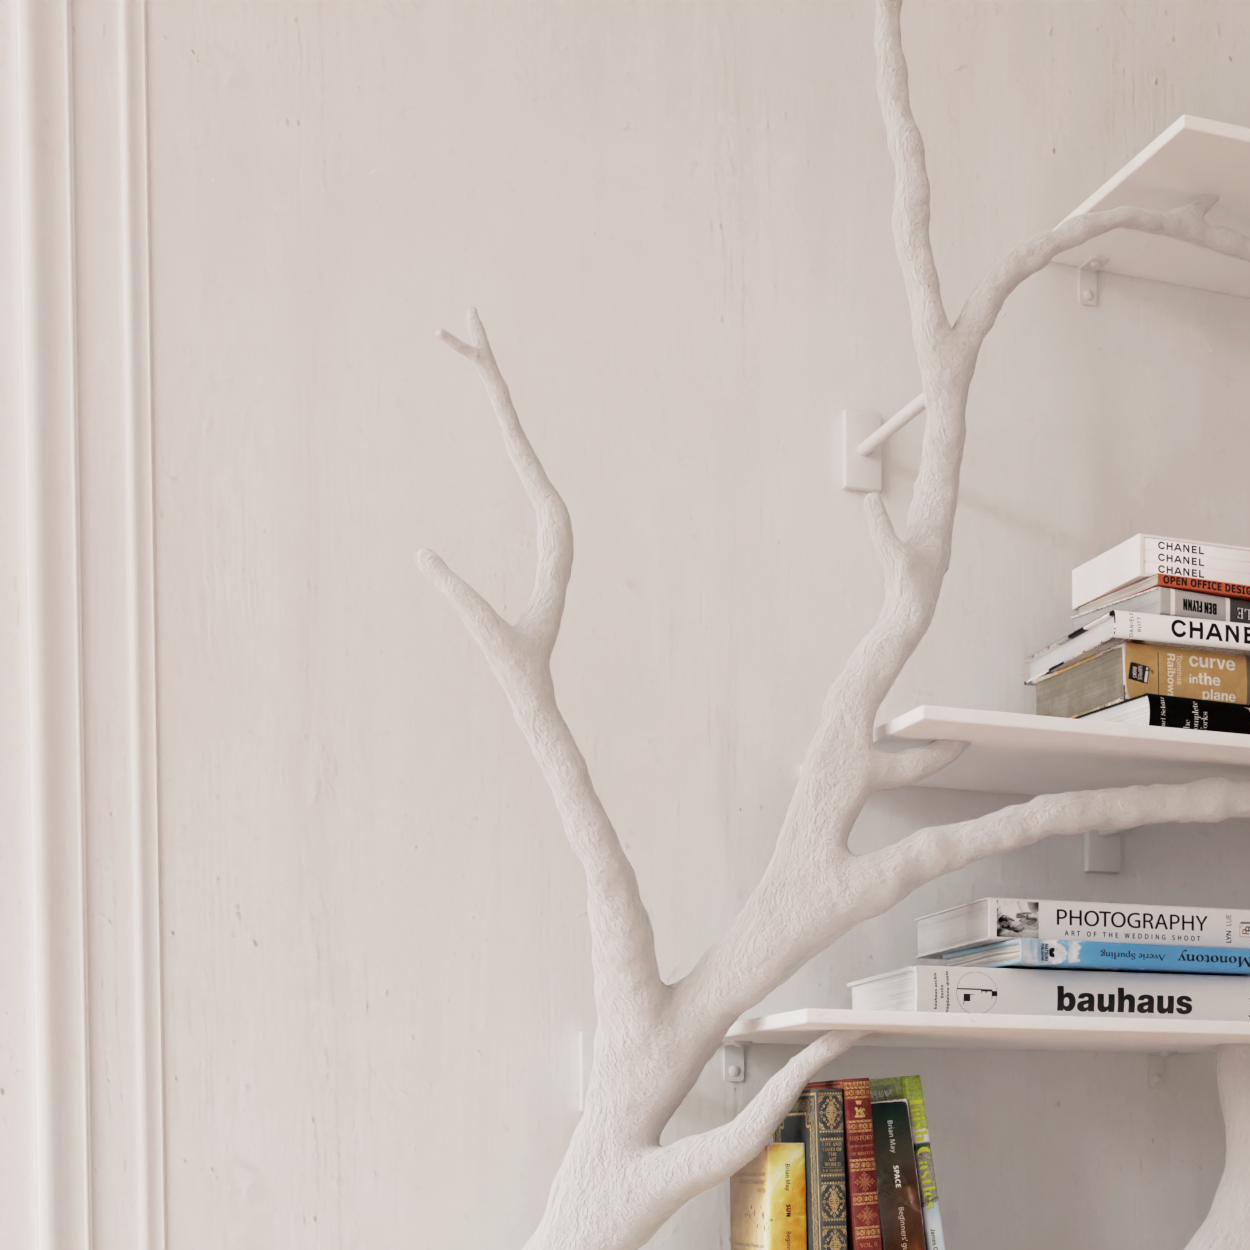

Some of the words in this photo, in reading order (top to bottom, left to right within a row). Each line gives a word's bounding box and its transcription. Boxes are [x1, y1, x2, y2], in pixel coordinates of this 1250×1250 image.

[1158, 542, 1204, 555] CHANEL
[1158, 554, 1204, 567] CHANEL
[1158, 565, 1204, 578] CHANEL
[1163, 576, 1187, 586] OPEN
[1190, 579, 1222, 591] OFFICE
[1183, 599, 1202, 612] FLYNN
[1205, 603, 1217, 615] BEN
[1189, 656, 1235, 671] curve
[1202, 689, 1236, 702] plane
[1056, 909, 1208, 932] PHOTOGRAPHY
[1124, 932, 1166, 941] WEDDING
[1172, 934, 1201, 942] SHOOT
[1100, 949, 1136, 960] Spurling
[1057, 986, 1192, 1015] bauhaus
[909, 1099, 928, 1142] Irish
[893, 1165, 901, 1188] SPACE
[917, 1146, 936, 1209] Castles
[898, 1206, 908, 1242] Beginners'
